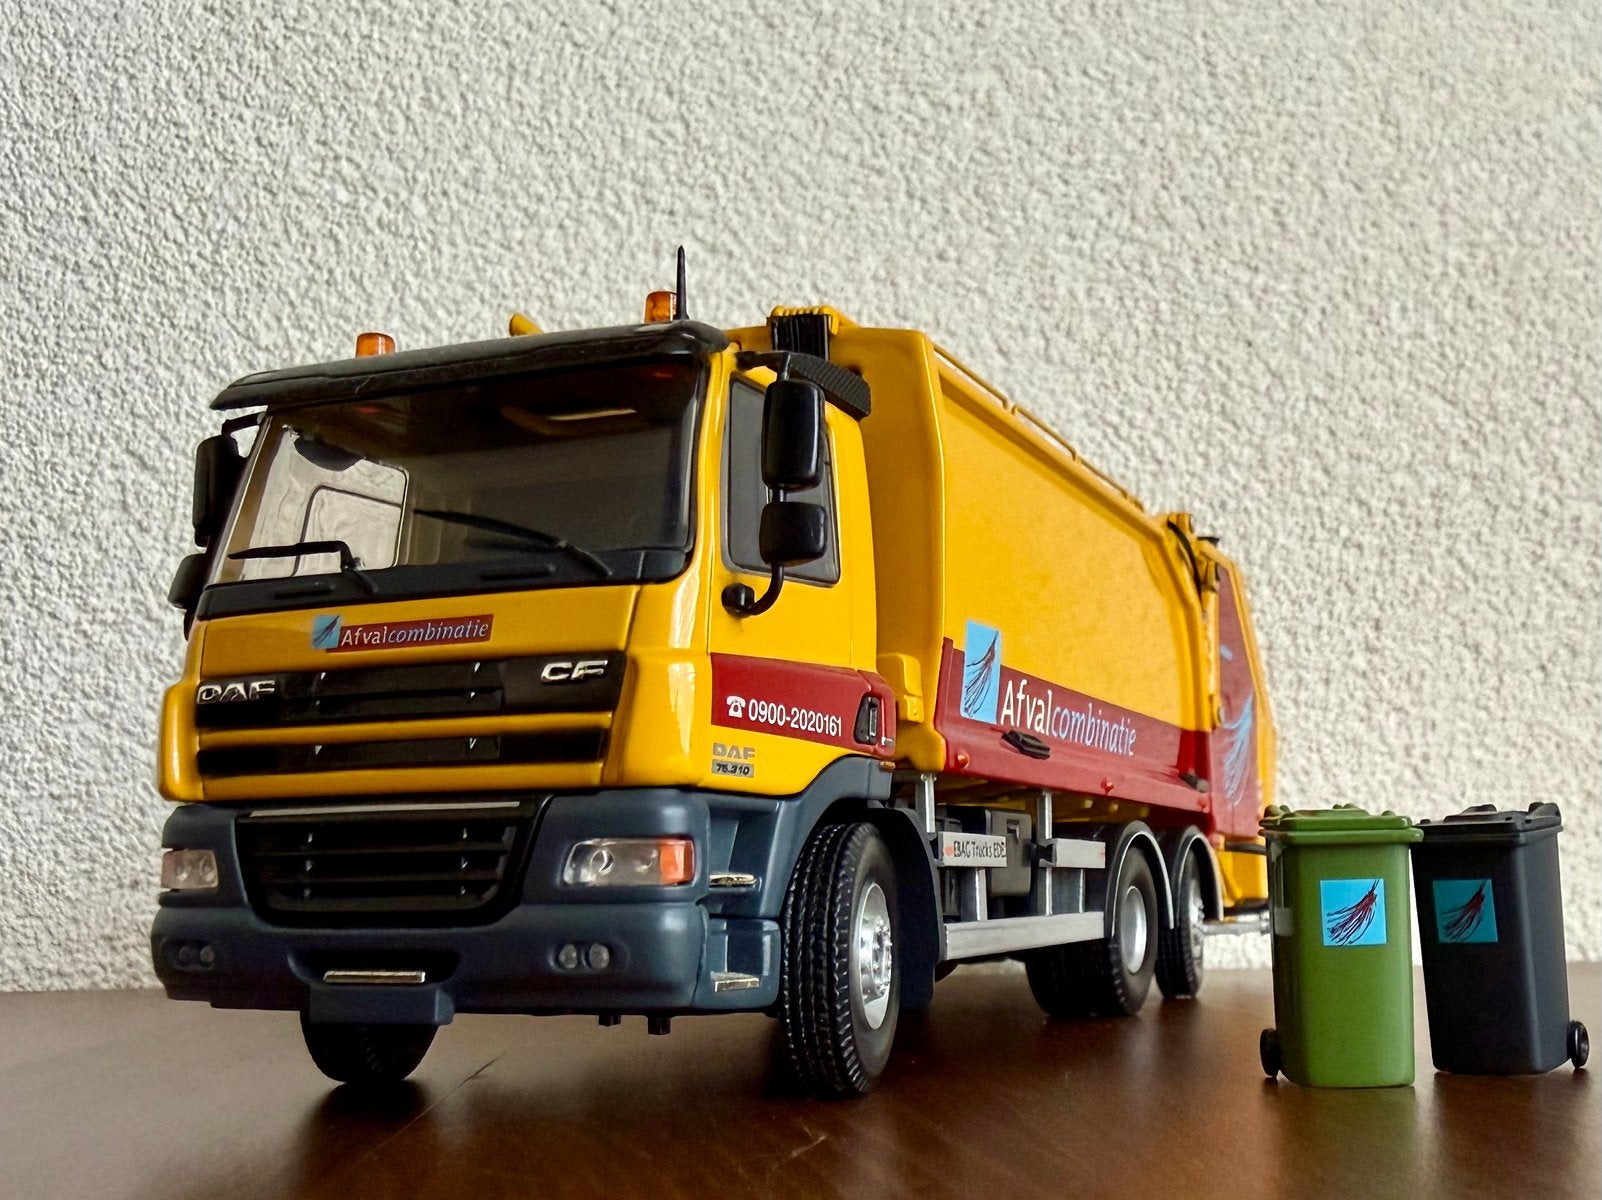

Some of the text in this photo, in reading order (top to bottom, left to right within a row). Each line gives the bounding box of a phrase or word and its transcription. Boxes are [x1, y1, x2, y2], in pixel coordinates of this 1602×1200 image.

[341, 620, 489, 647] Afvalcombinatie
[540, 660, 609, 684] CF
[196, 680, 276, 705] DAF
[748, 698, 842, 737] 0900-2020161
[1000, 679, 1137, 756] Afvalcombinatie
[713, 743, 755, 760] DAF
[715, 762, 750, 776] 75.310
[971, 841, 992, 858] Trucks
